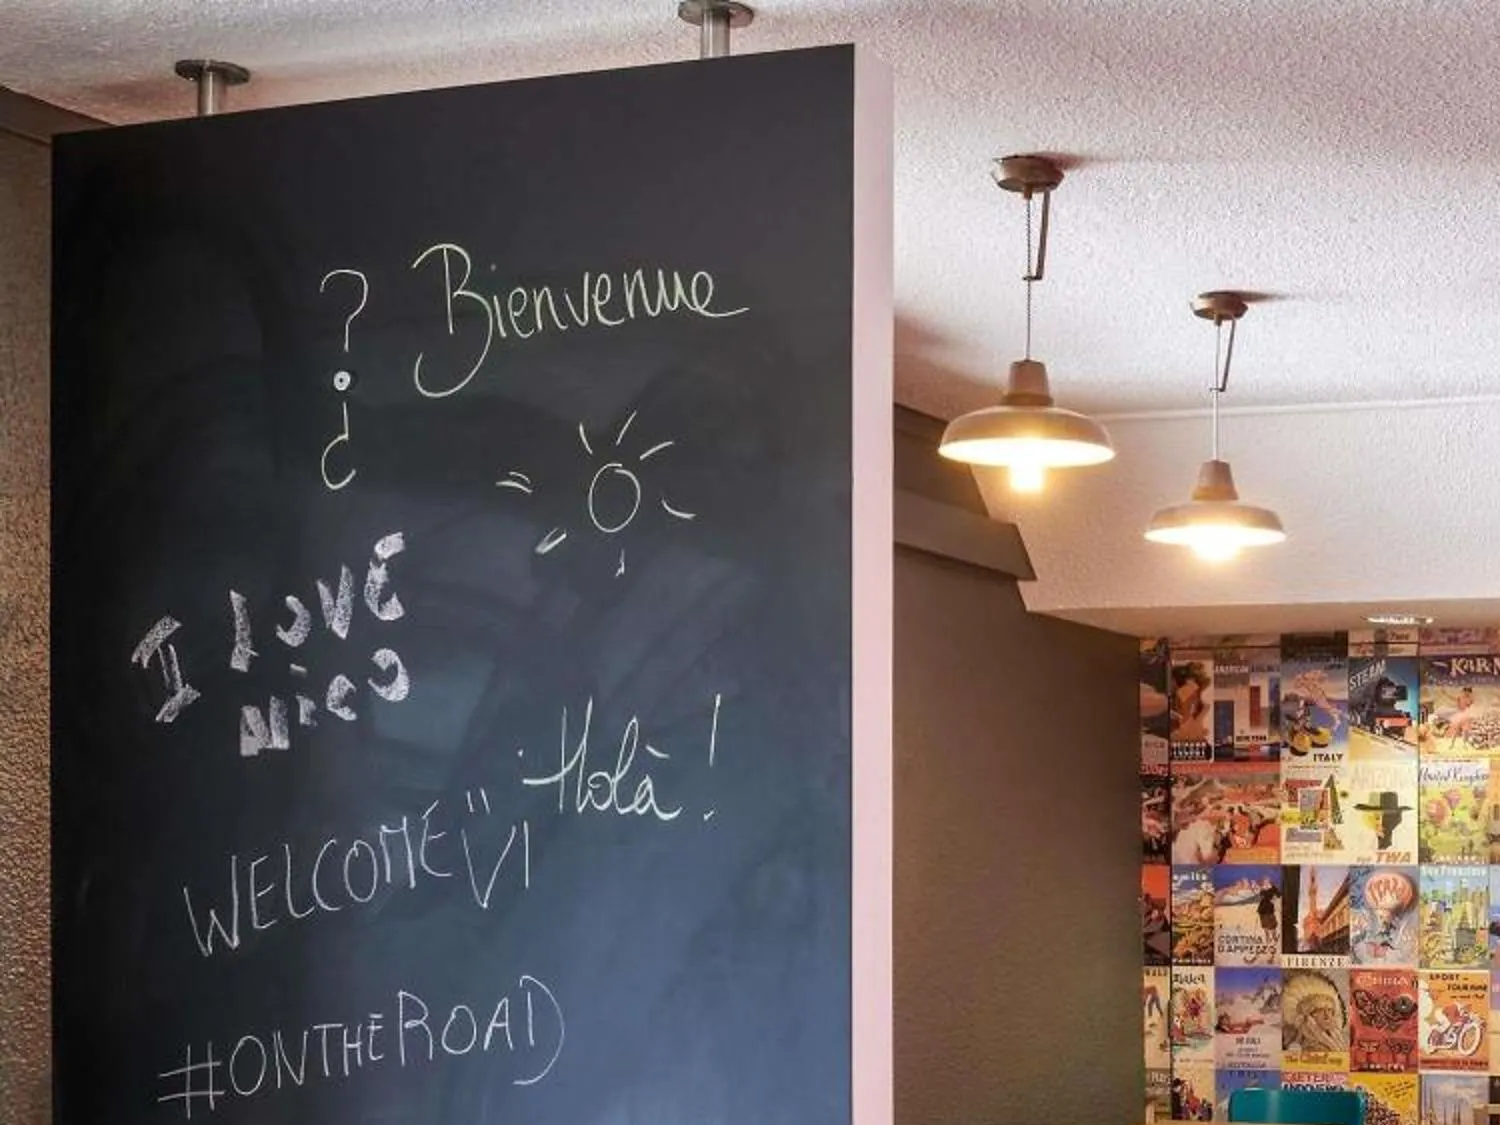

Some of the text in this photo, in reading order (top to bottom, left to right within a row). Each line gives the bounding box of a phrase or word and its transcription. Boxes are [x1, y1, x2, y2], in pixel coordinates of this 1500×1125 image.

[412, 243, 750, 397] Bienvenue
[1313, 753, 1343, 763] ITALY
[1375, 851, 1412, 863] TWA
[1287, 957, 1346, 967] FIRENZE
